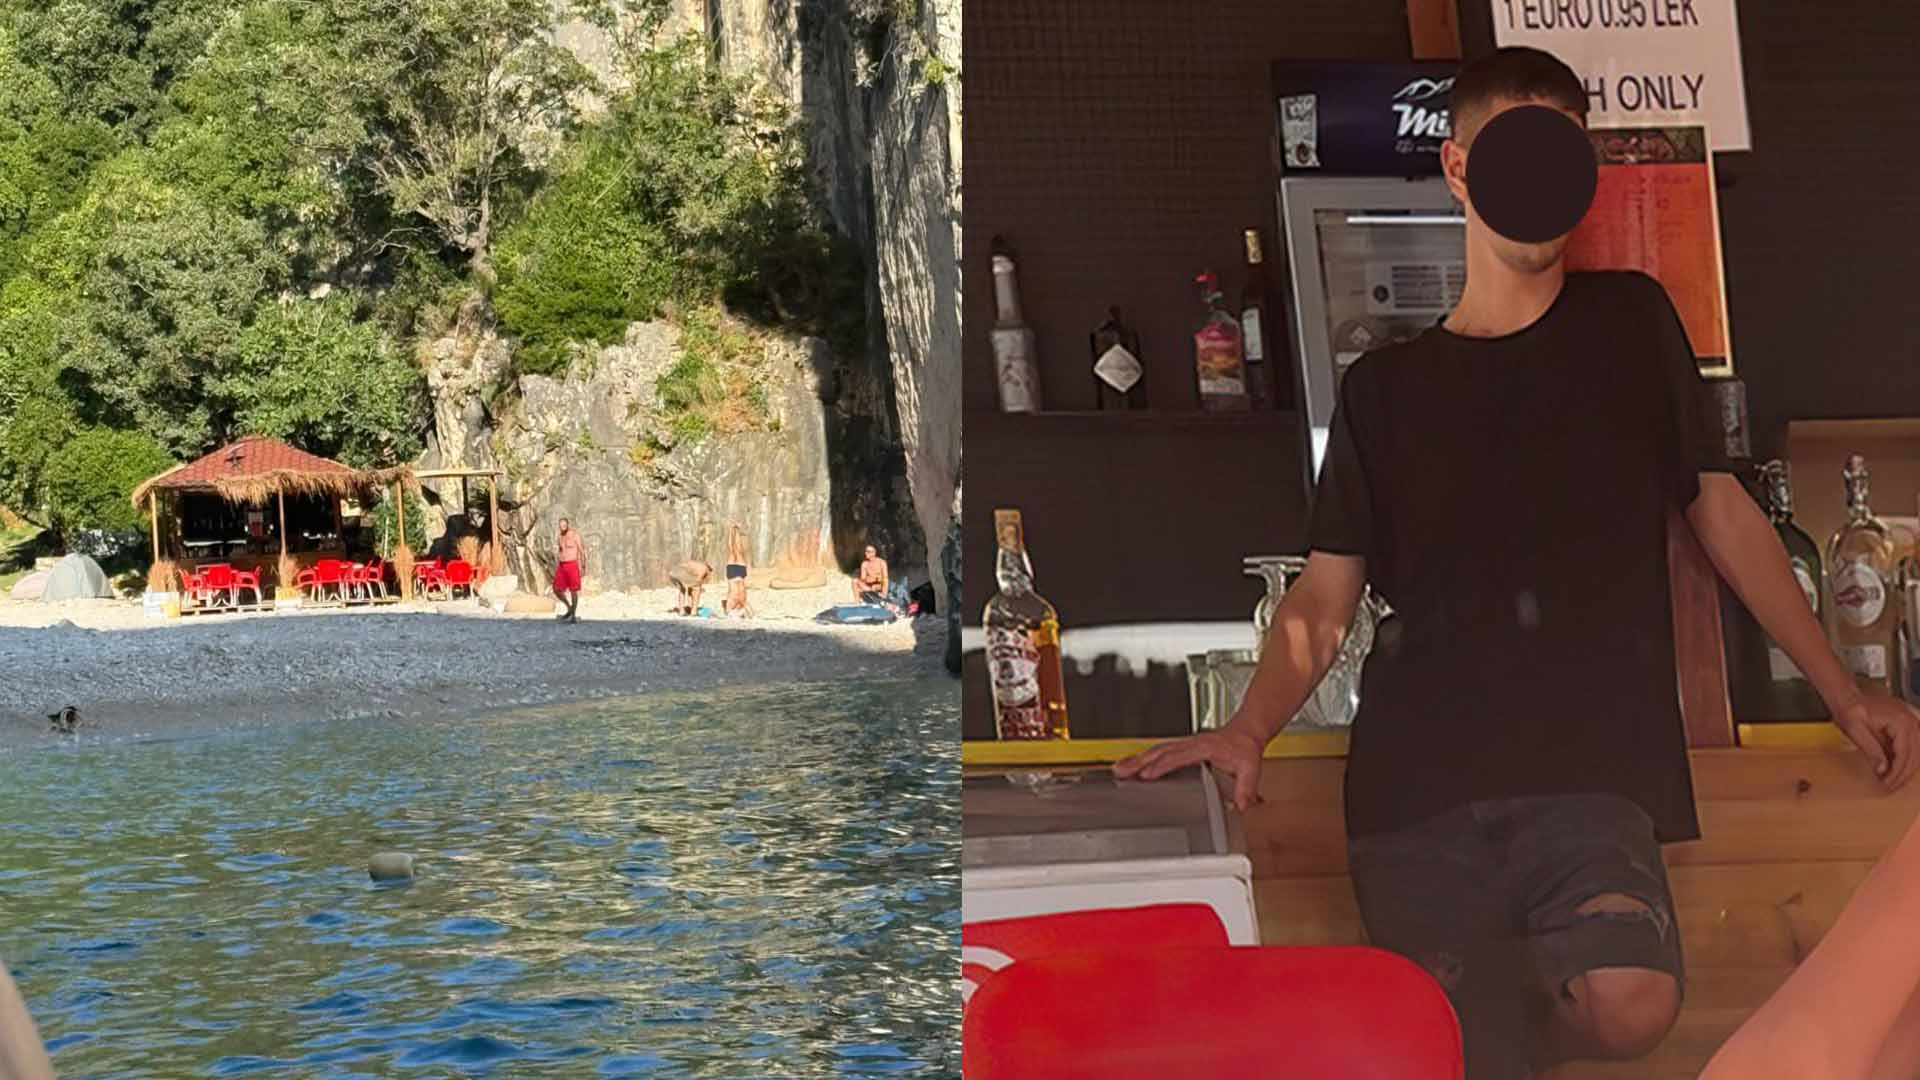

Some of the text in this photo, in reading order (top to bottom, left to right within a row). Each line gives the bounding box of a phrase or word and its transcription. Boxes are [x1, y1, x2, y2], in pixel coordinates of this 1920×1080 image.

[1524, 0, 1593, 29] EURO
[1600, 0, 1647, 28] 0.95
[1653, 0, 1699, 26] LEK
[1616, 74, 1704, 111] ONLY
